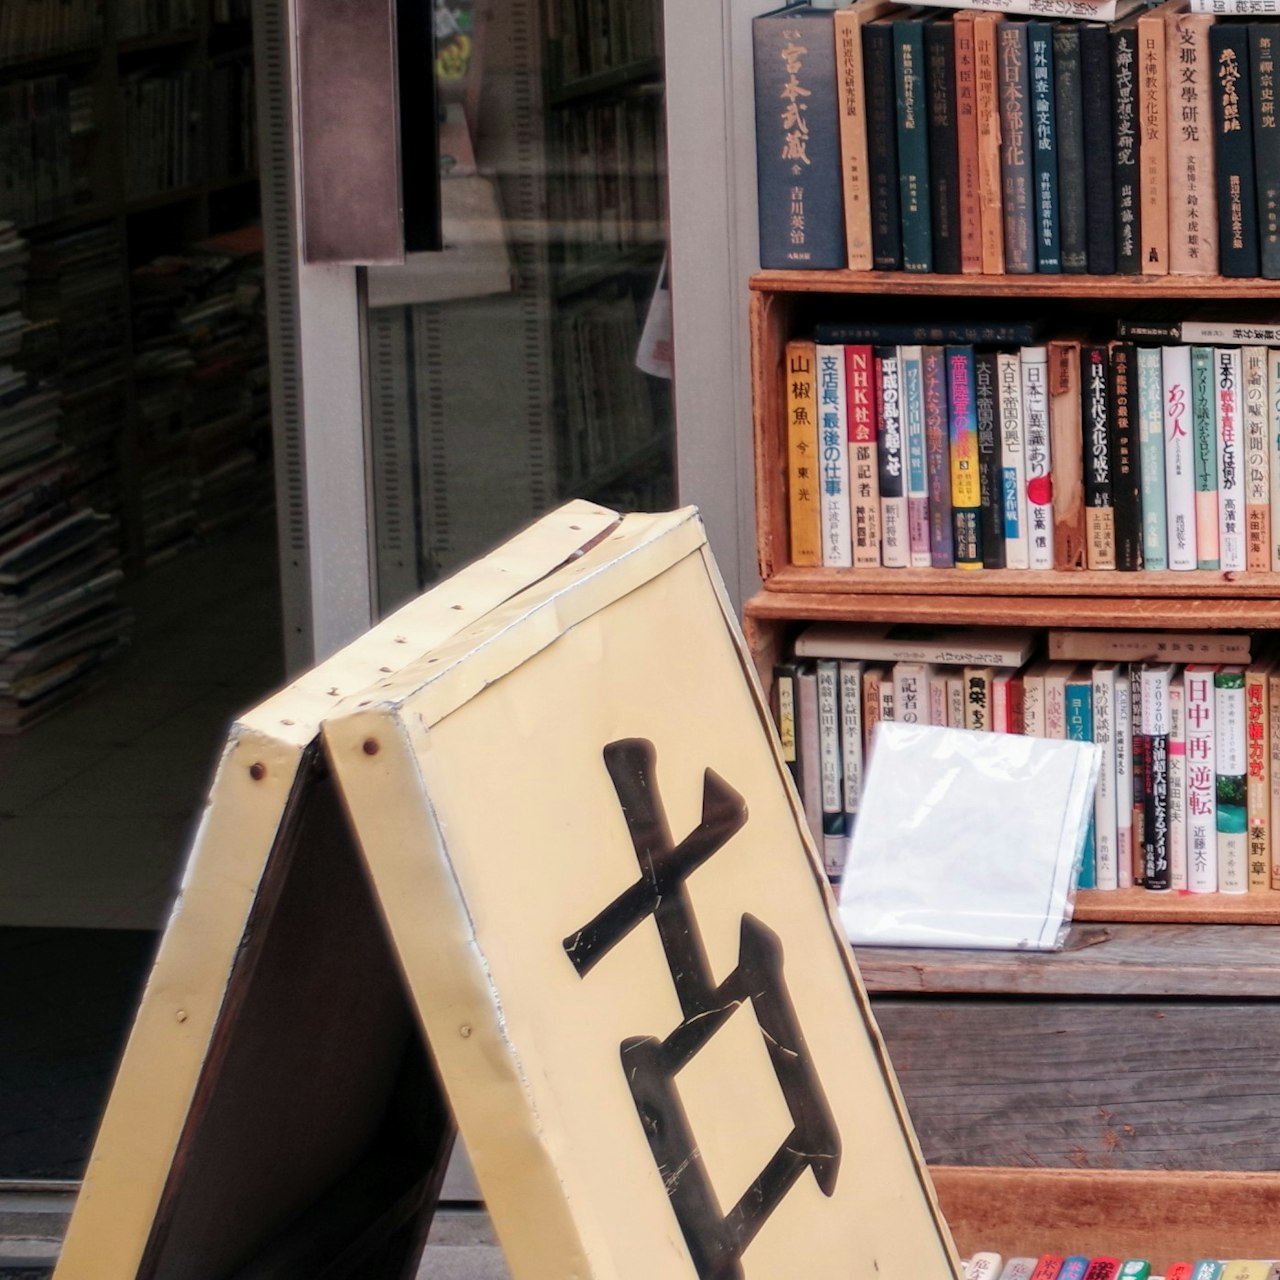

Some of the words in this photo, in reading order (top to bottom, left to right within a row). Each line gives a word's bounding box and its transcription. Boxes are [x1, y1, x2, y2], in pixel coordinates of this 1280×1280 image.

[791, 356, 812, 425] 山椒魚
[821, 356, 841, 496] 支店長、最後の仕事
[1168, 384, 1187, 442] あの人
[563, 738, 842, 1280] 古
